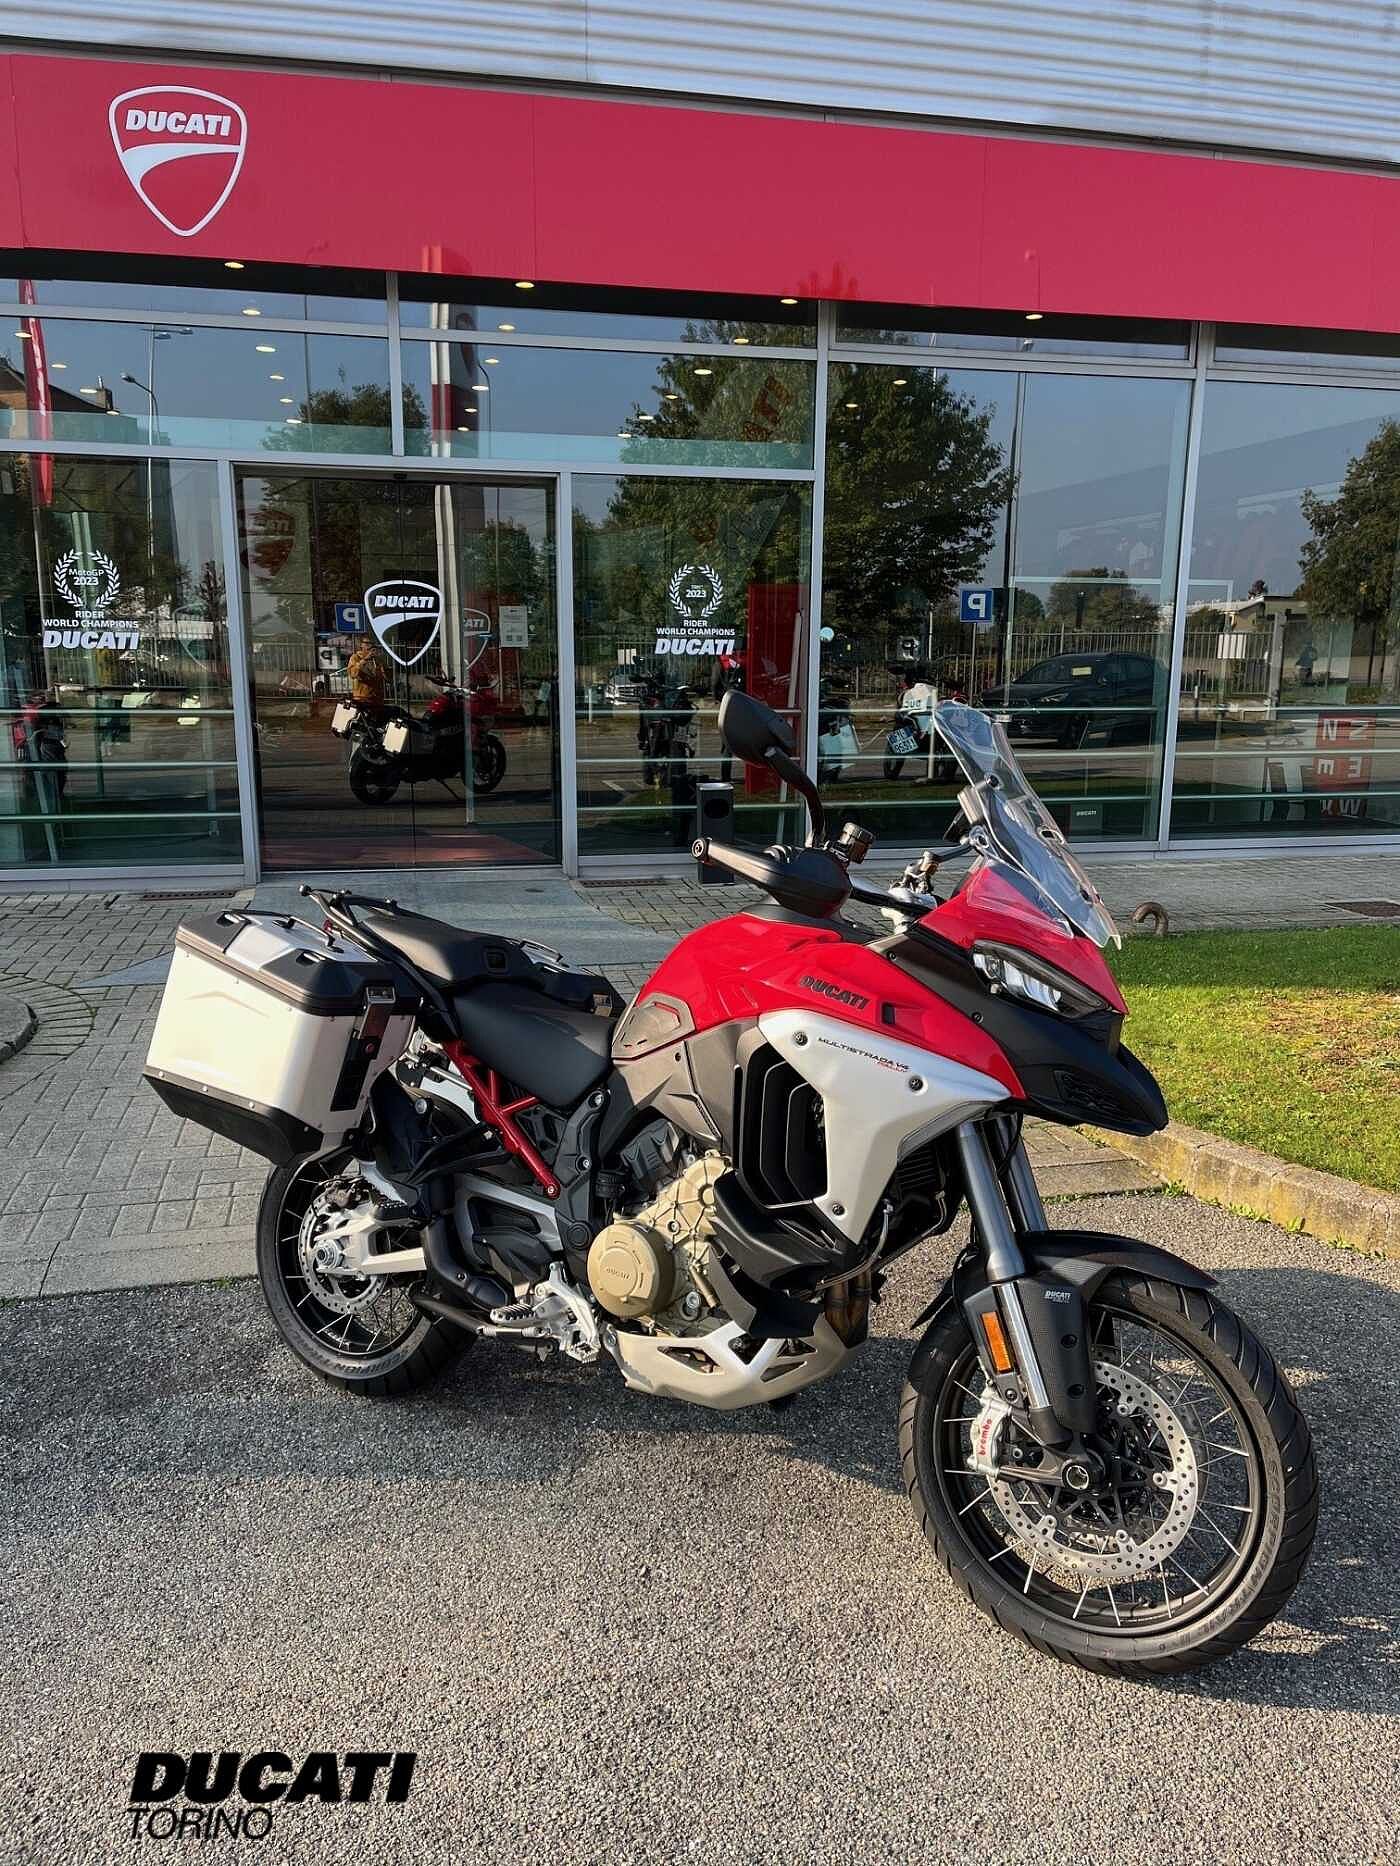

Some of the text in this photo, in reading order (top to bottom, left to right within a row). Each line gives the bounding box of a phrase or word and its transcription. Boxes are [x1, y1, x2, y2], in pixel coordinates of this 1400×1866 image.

[125, 109, 231, 137] DUCATI
[68, 569, 104, 577] MotoGP
[73, 577, 99, 586] 2023
[686, 590, 707, 598] 2023
[374, 595, 434, 609] DUCATI
[75, 610, 105, 619] RIDER
[43, 619, 139, 629] WORLD CHAMPIONS
[683, 619, 708, 627] RIDER
[656, 627, 736, 636] WORLD CHAMPIONS
[43, 630, 140, 650] DUCATI
[654, 638, 735, 655] DUCATI
[801, 975, 870, 1009] DUCATI
[817, 1037, 894, 1065] MULTISTRADA
[1045, 1290, 1072, 1300] DUCATI
[979, 1418, 993, 1456] brembo
